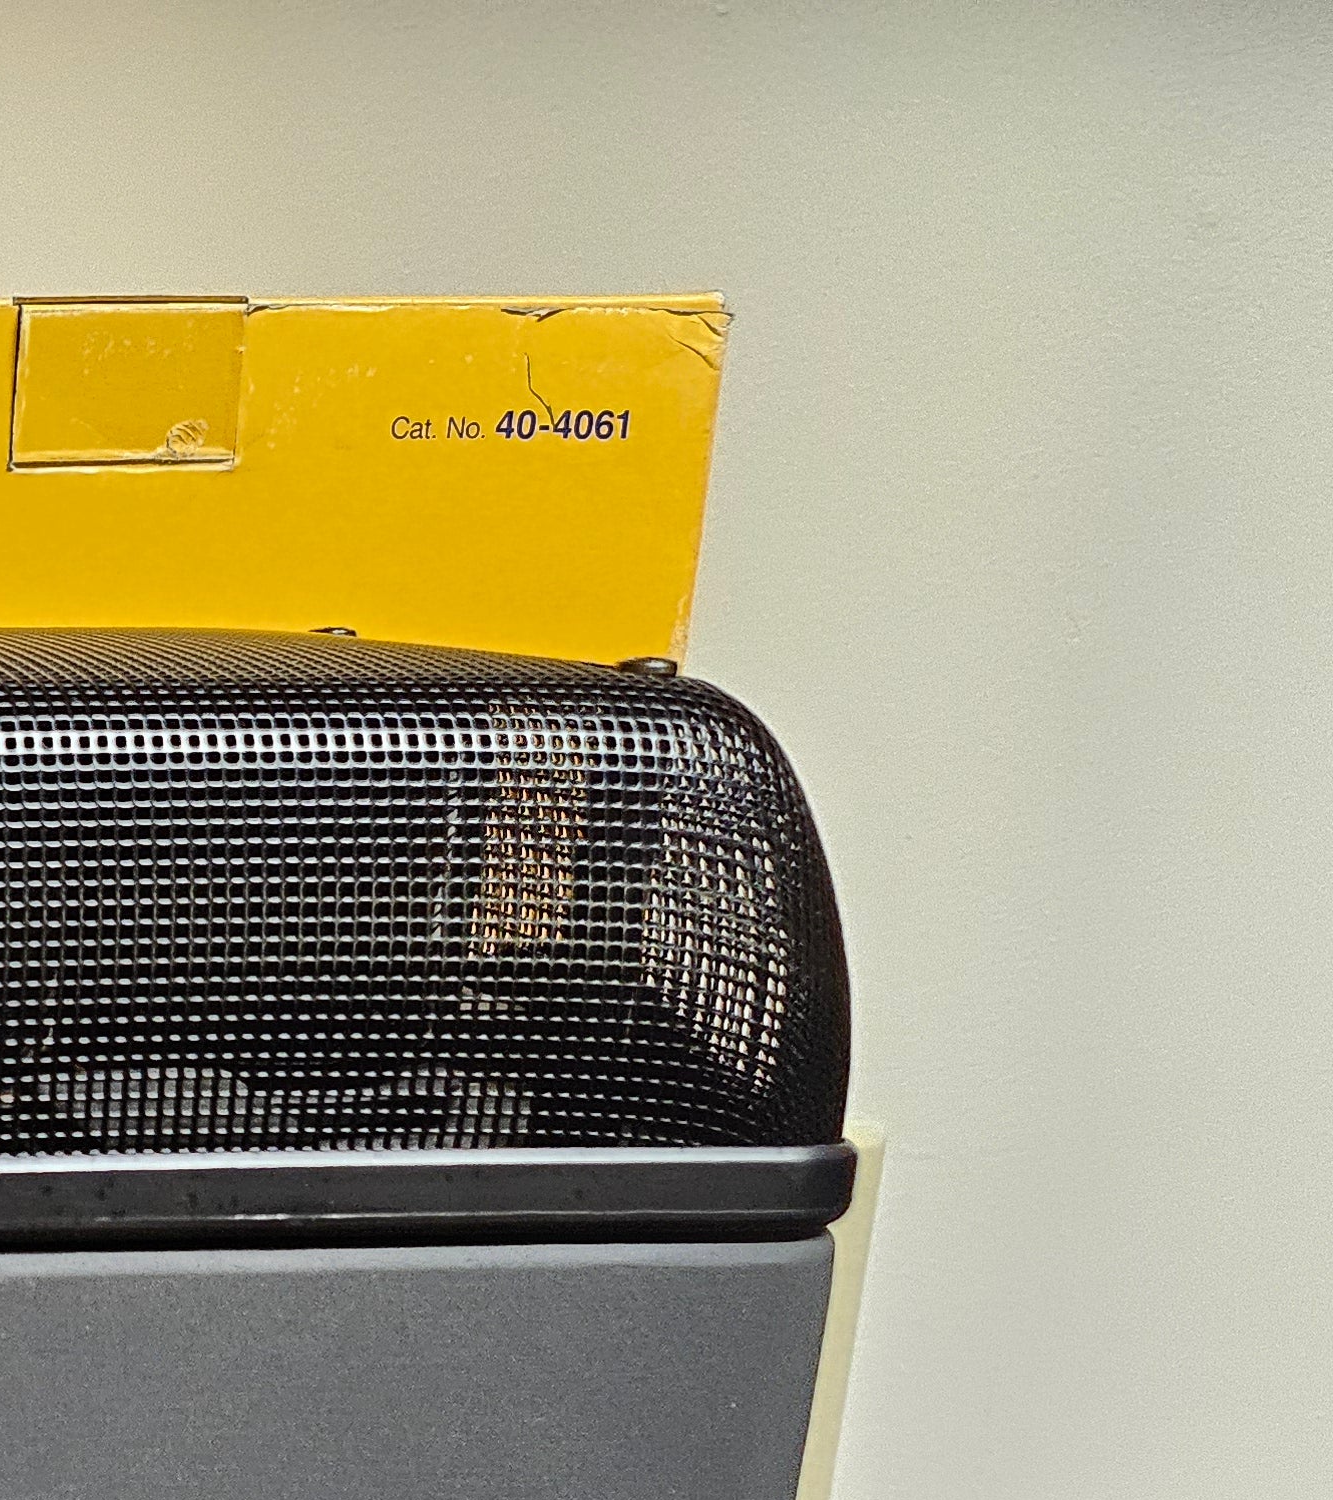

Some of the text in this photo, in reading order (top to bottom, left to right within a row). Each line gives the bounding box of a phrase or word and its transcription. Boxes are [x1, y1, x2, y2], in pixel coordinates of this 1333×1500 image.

[392, 410, 630, 440] Cat. No. 40-4061
